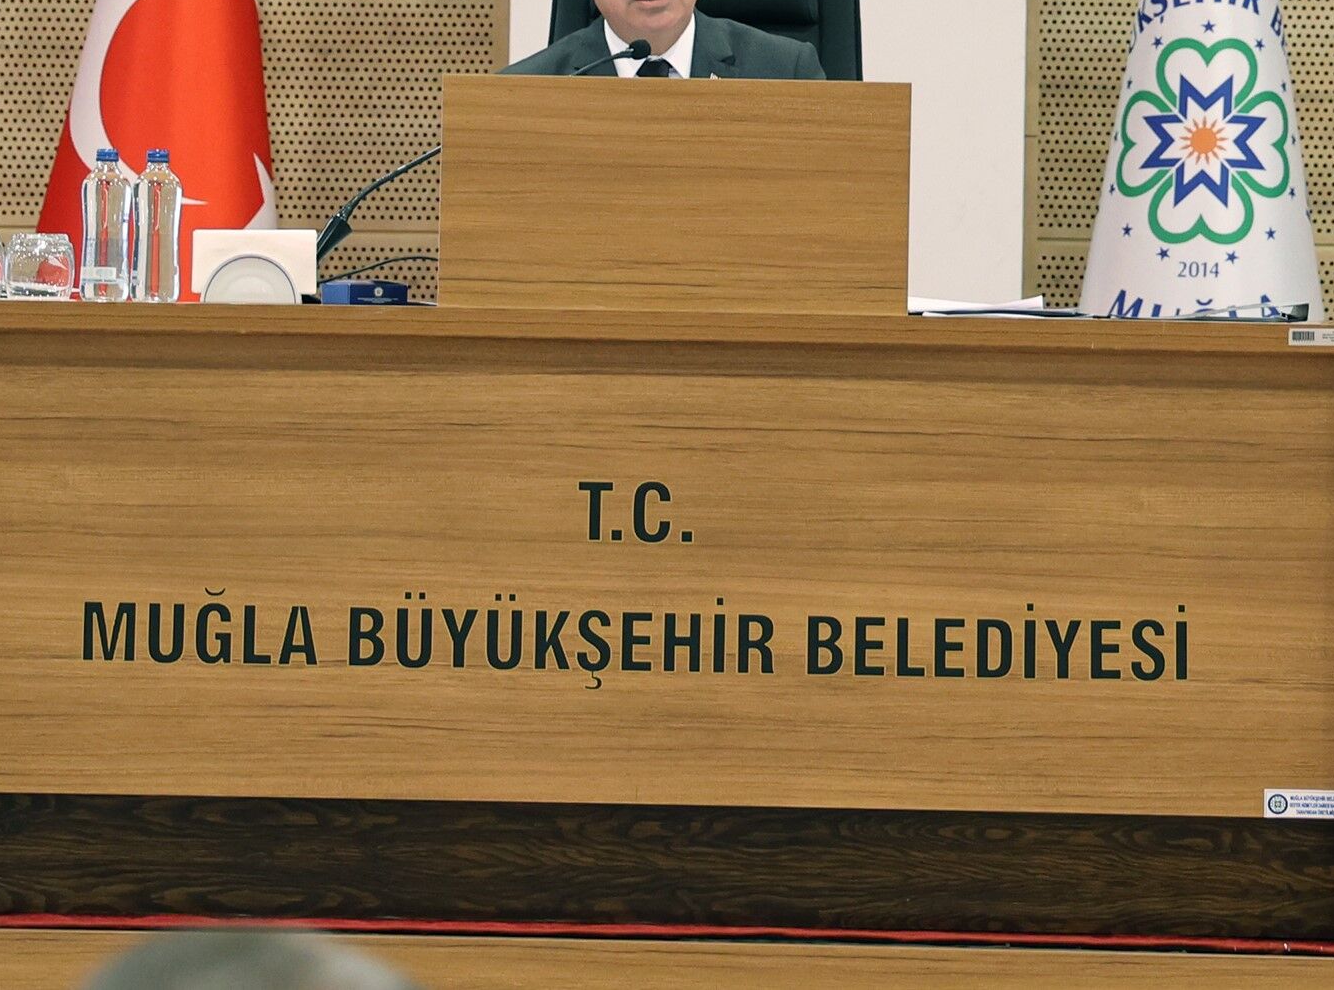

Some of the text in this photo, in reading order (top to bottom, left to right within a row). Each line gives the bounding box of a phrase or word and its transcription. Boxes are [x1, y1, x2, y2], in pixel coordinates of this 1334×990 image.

[1177, 261, 1220, 278] 2014
[578, 481, 693, 543] T.C.
[82, 586, 1188, 690] MUĞLA BÜYÜKŞEHİR BELEDİYESİ
